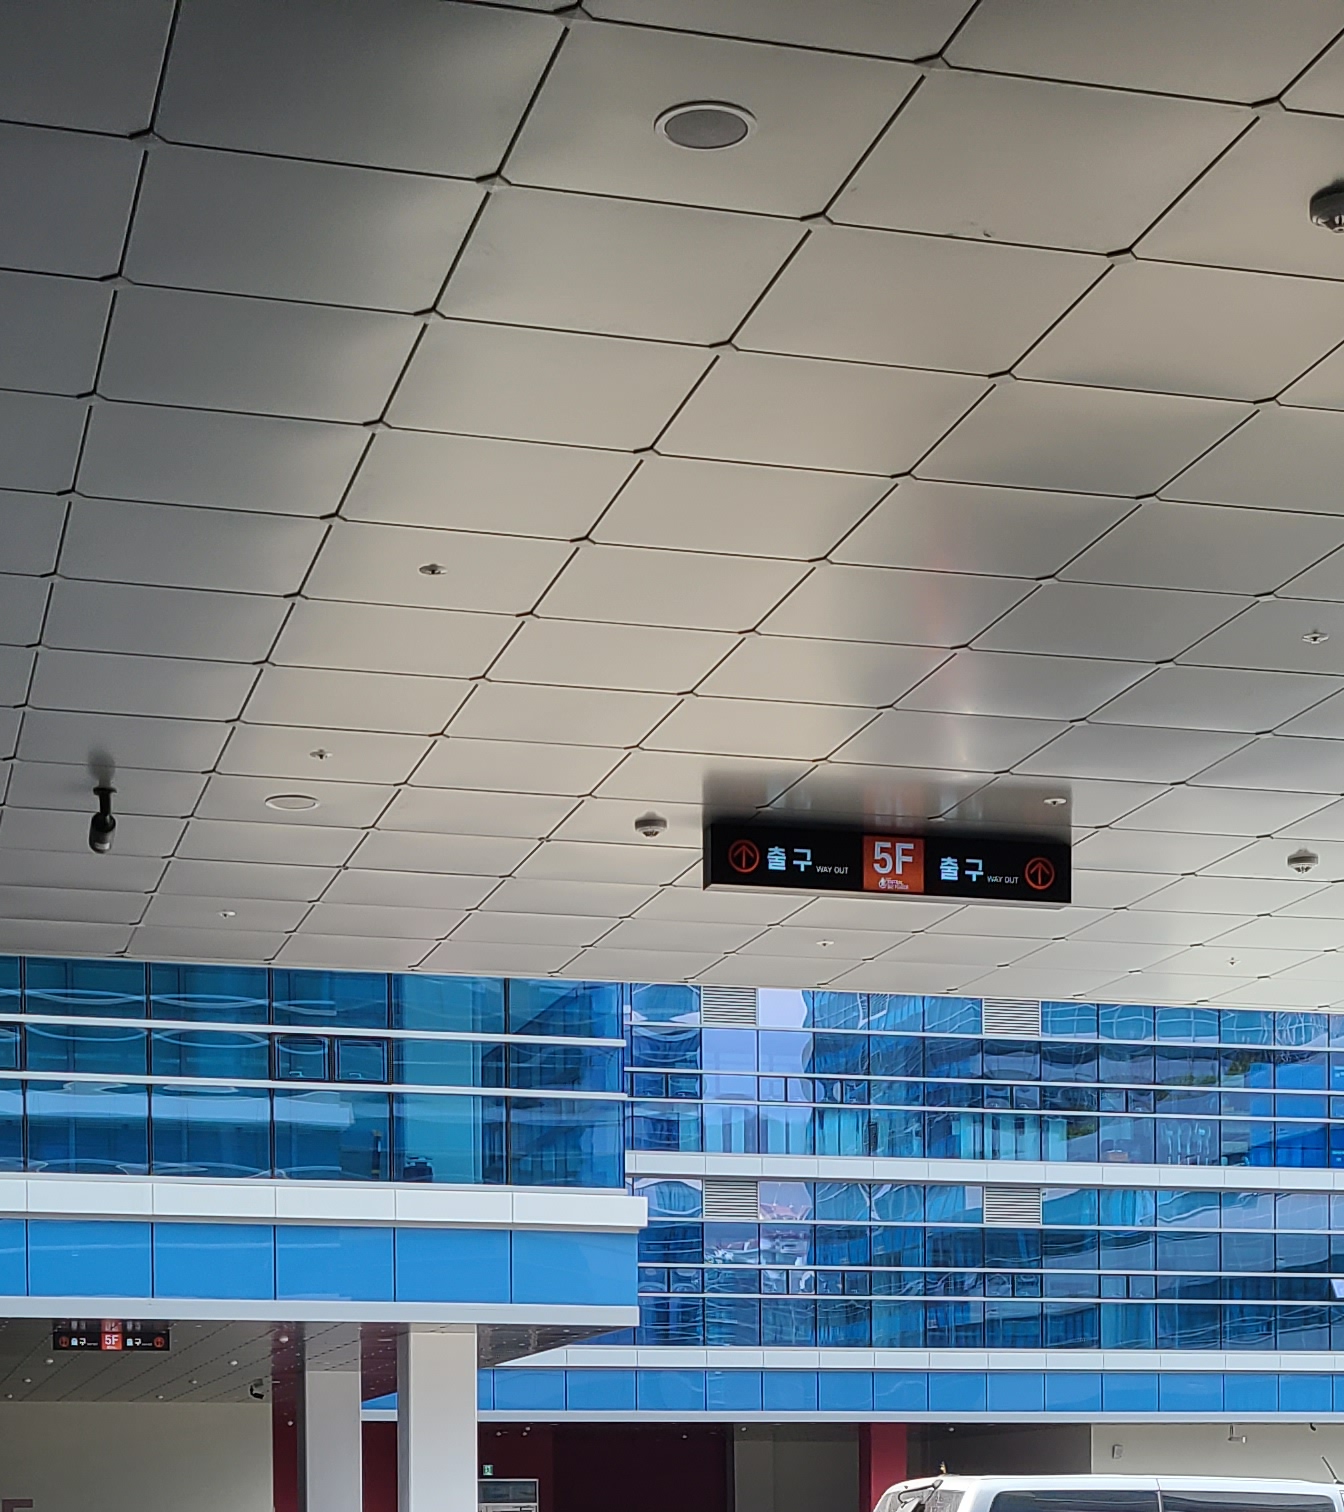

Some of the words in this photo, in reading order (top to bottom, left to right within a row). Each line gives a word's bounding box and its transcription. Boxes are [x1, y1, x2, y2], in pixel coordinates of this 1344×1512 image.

[767, 846, 812, 872] 출구
[816, 865, 833, 873] WAY
[834, 866, 849, 874] OUT
[873, 841, 915, 875] 5F
[940, 856, 984, 882] 출구
[105, 1334, 119, 1346] 5F
